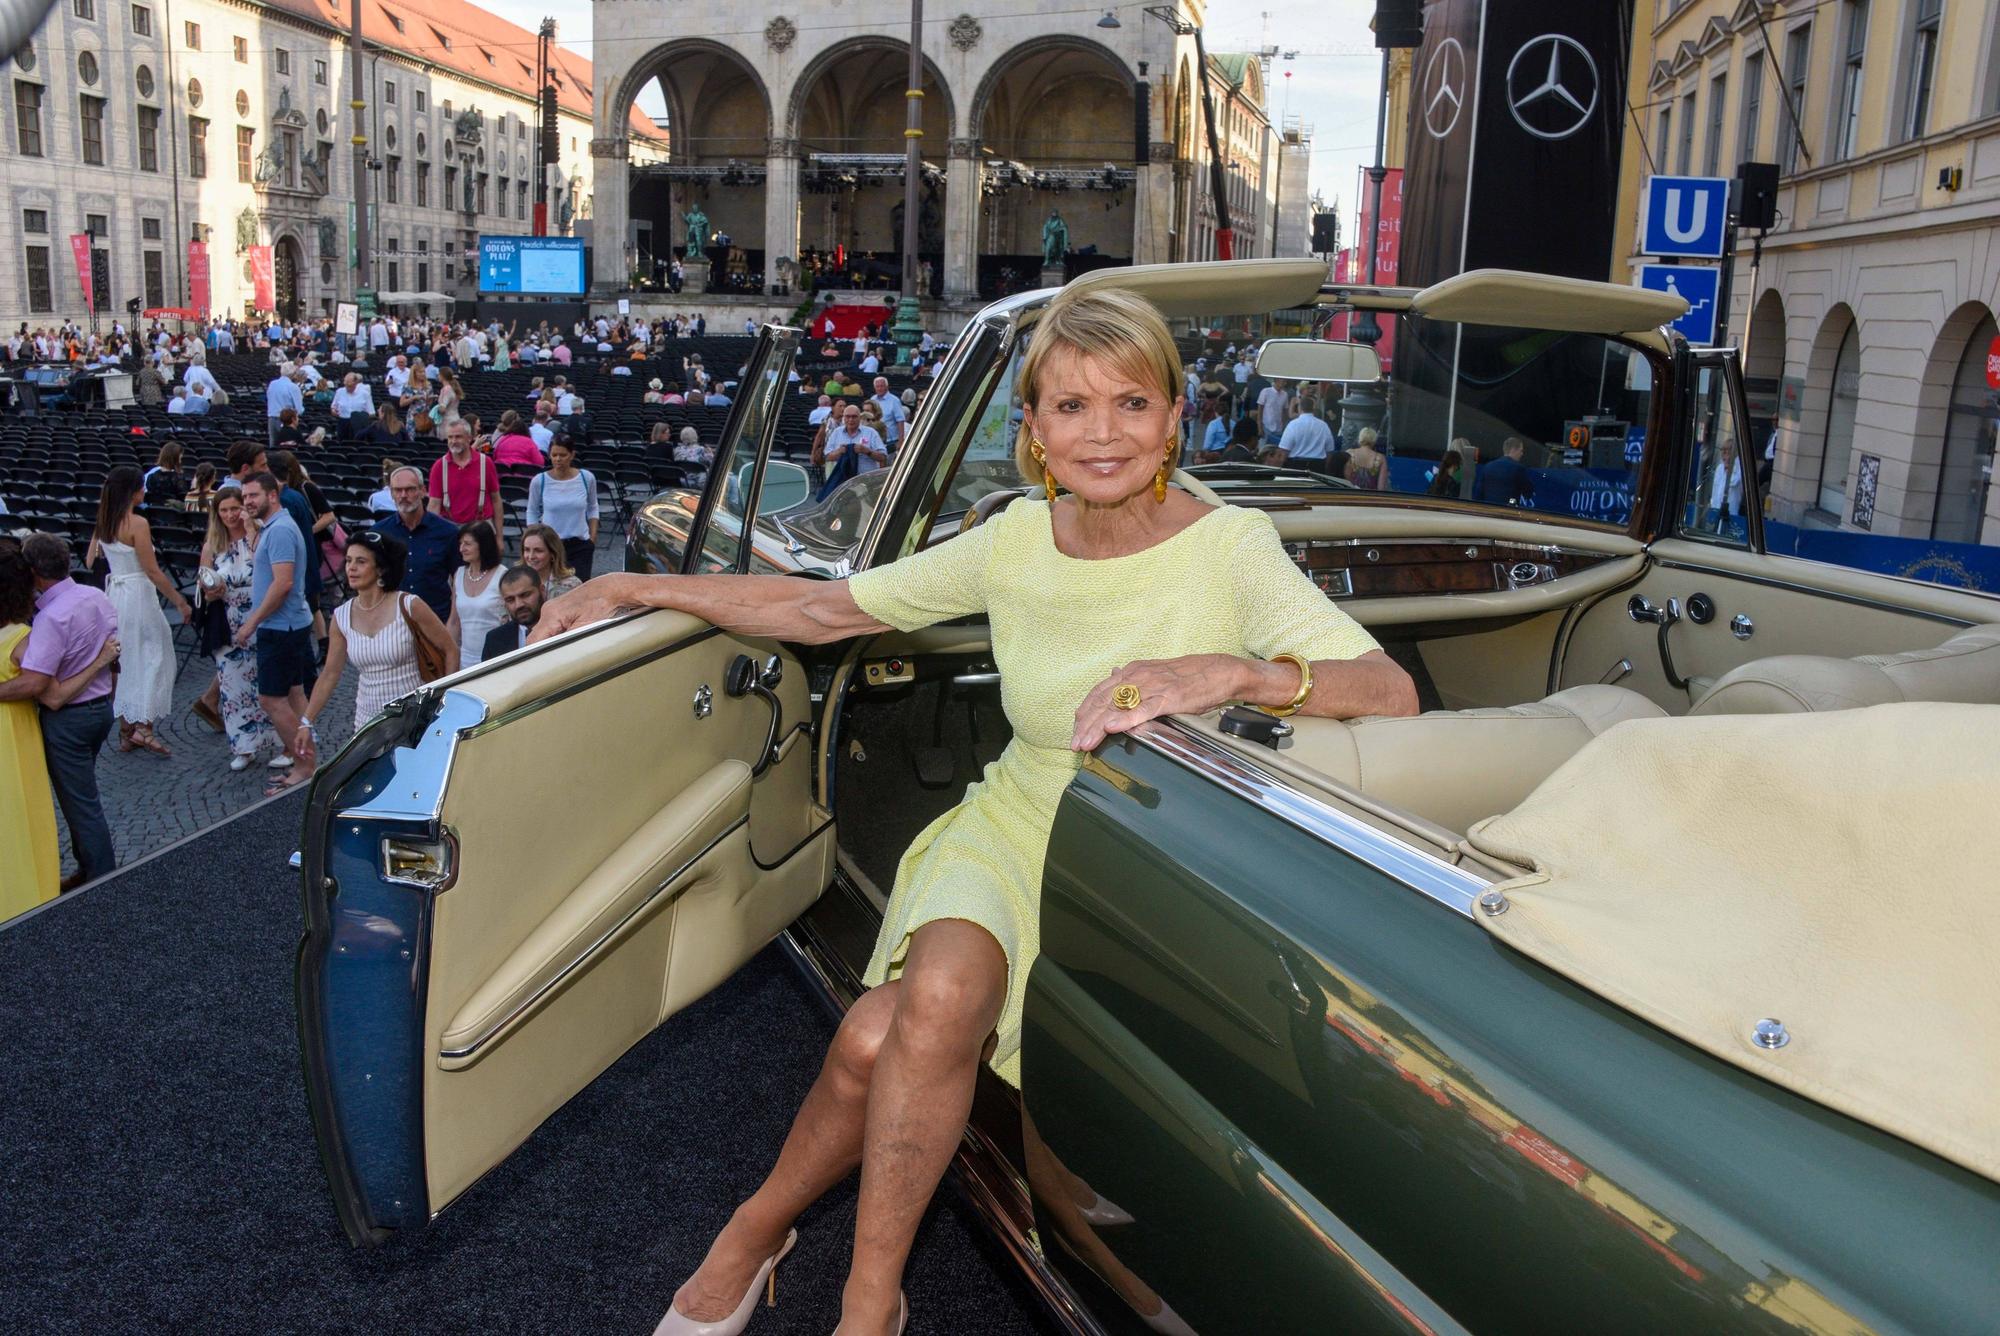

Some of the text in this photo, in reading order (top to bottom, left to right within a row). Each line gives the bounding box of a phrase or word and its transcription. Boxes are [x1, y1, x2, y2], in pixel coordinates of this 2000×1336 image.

[1664, 188, 1709, 244] U
[485, 244, 516, 252] ODEONS
[490, 252, 511, 261] PLATZ
